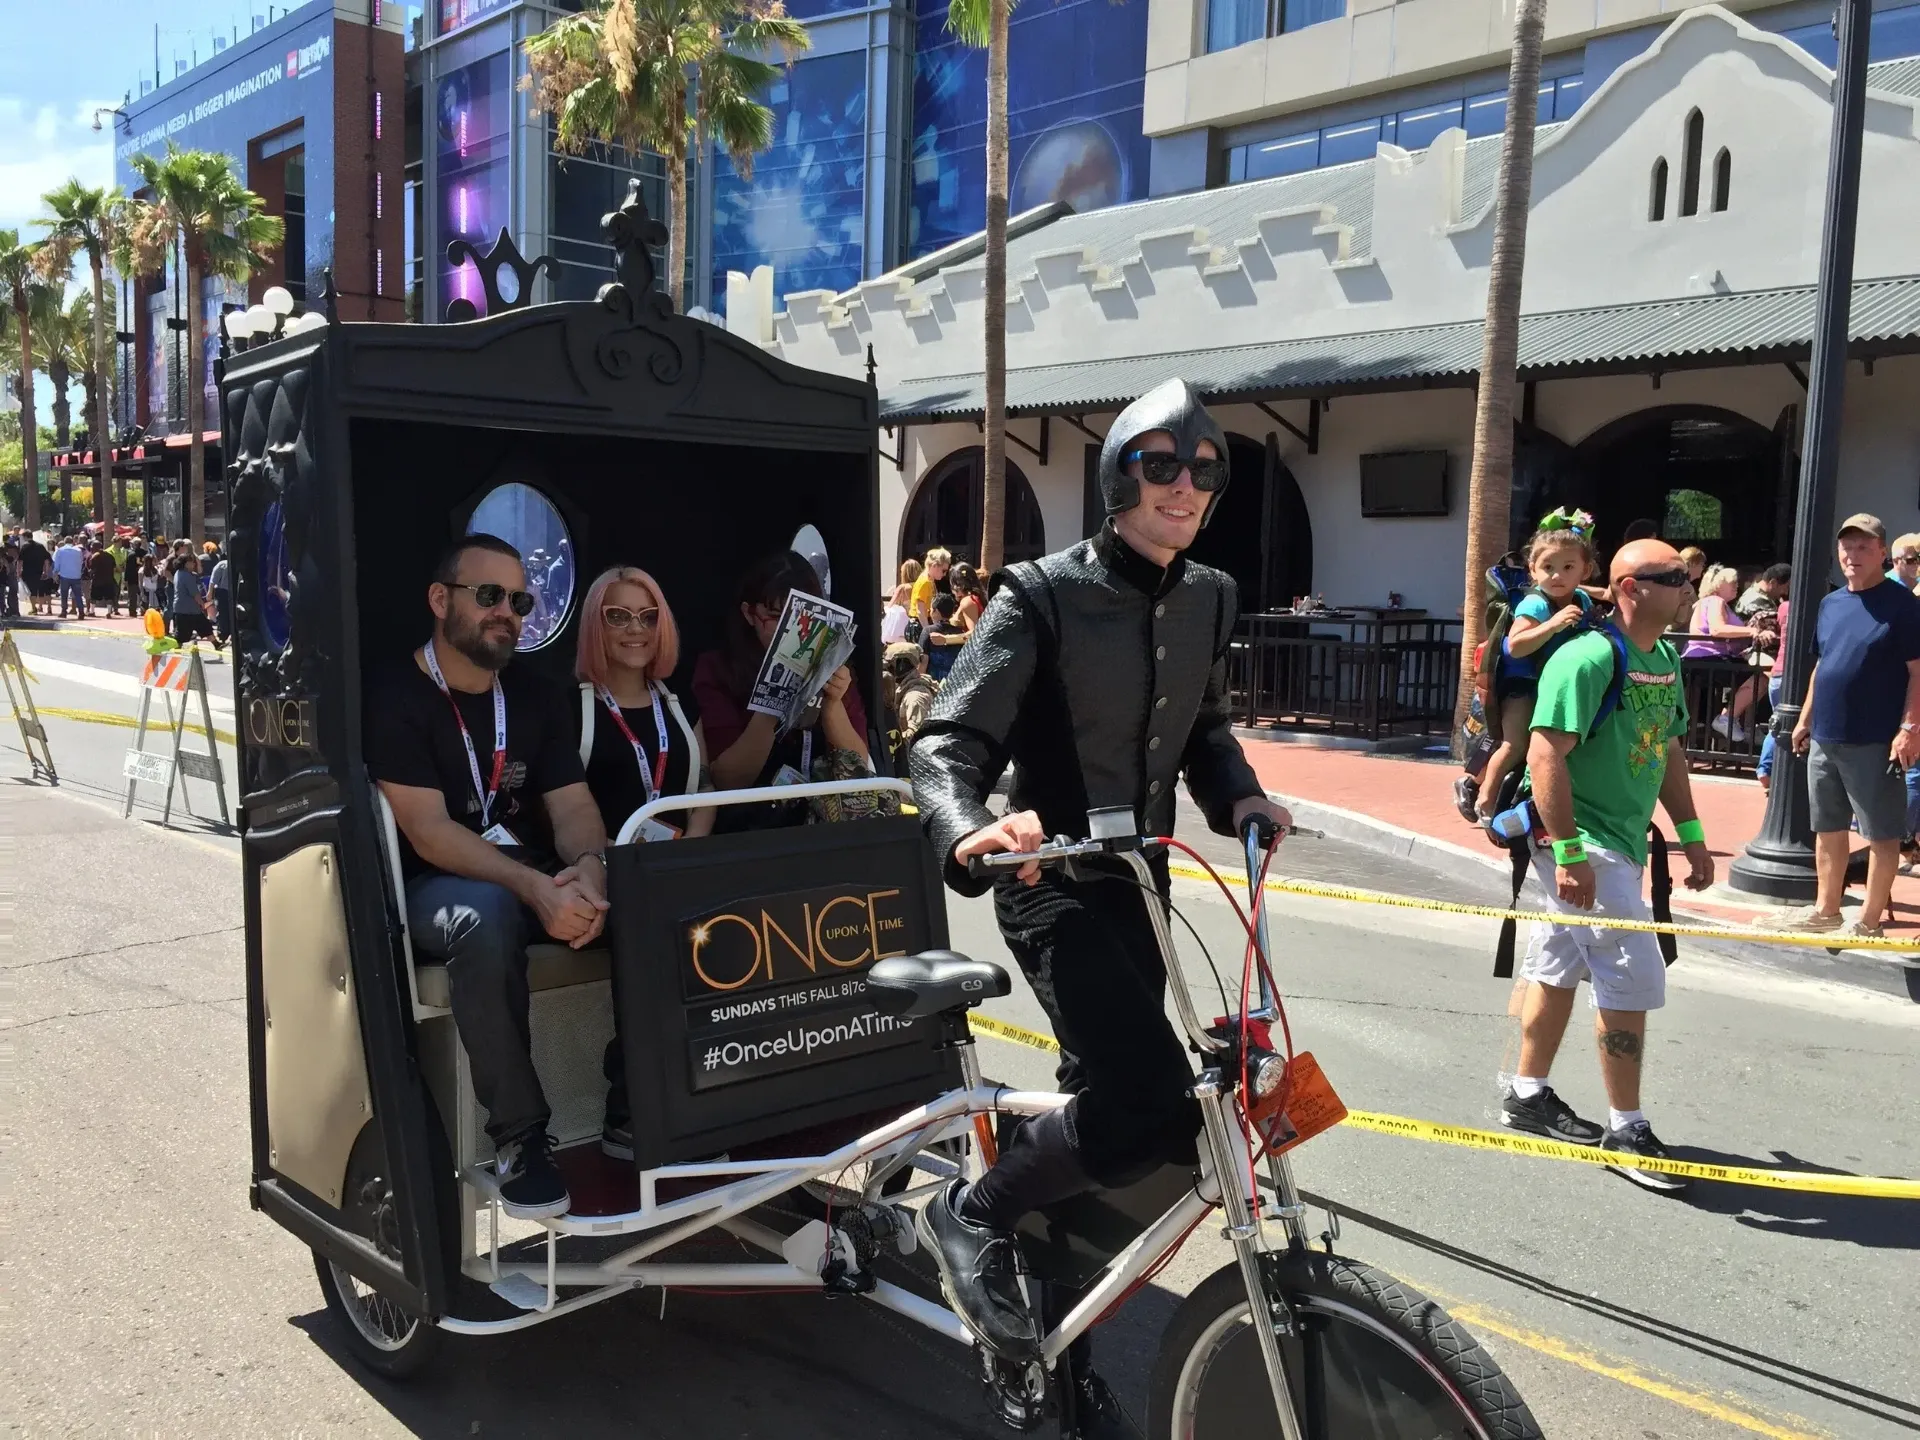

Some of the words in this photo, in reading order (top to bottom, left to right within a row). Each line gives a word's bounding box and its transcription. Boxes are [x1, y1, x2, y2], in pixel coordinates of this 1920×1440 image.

[141, 123, 166, 148] GONNA
[166, 113, 186, 135] NEED
[187, 109, 194, 125] A
[195, 93, 224, 121] BIGGER
[225, 63, 282, 106] IMAGINATION
[250, 699, 310, 746] ONCE
[693, 889, 906, 989] ONCE
[826, 924, 858, 940] UPON
[862, 921, 870, 934] A
[877, 917, 904, 931] TIME
[711, 998, 776, 1022] SUNDAYS
[778, 991, 807, 1009] THIS
[810, 986, 838, 1002] FALL
